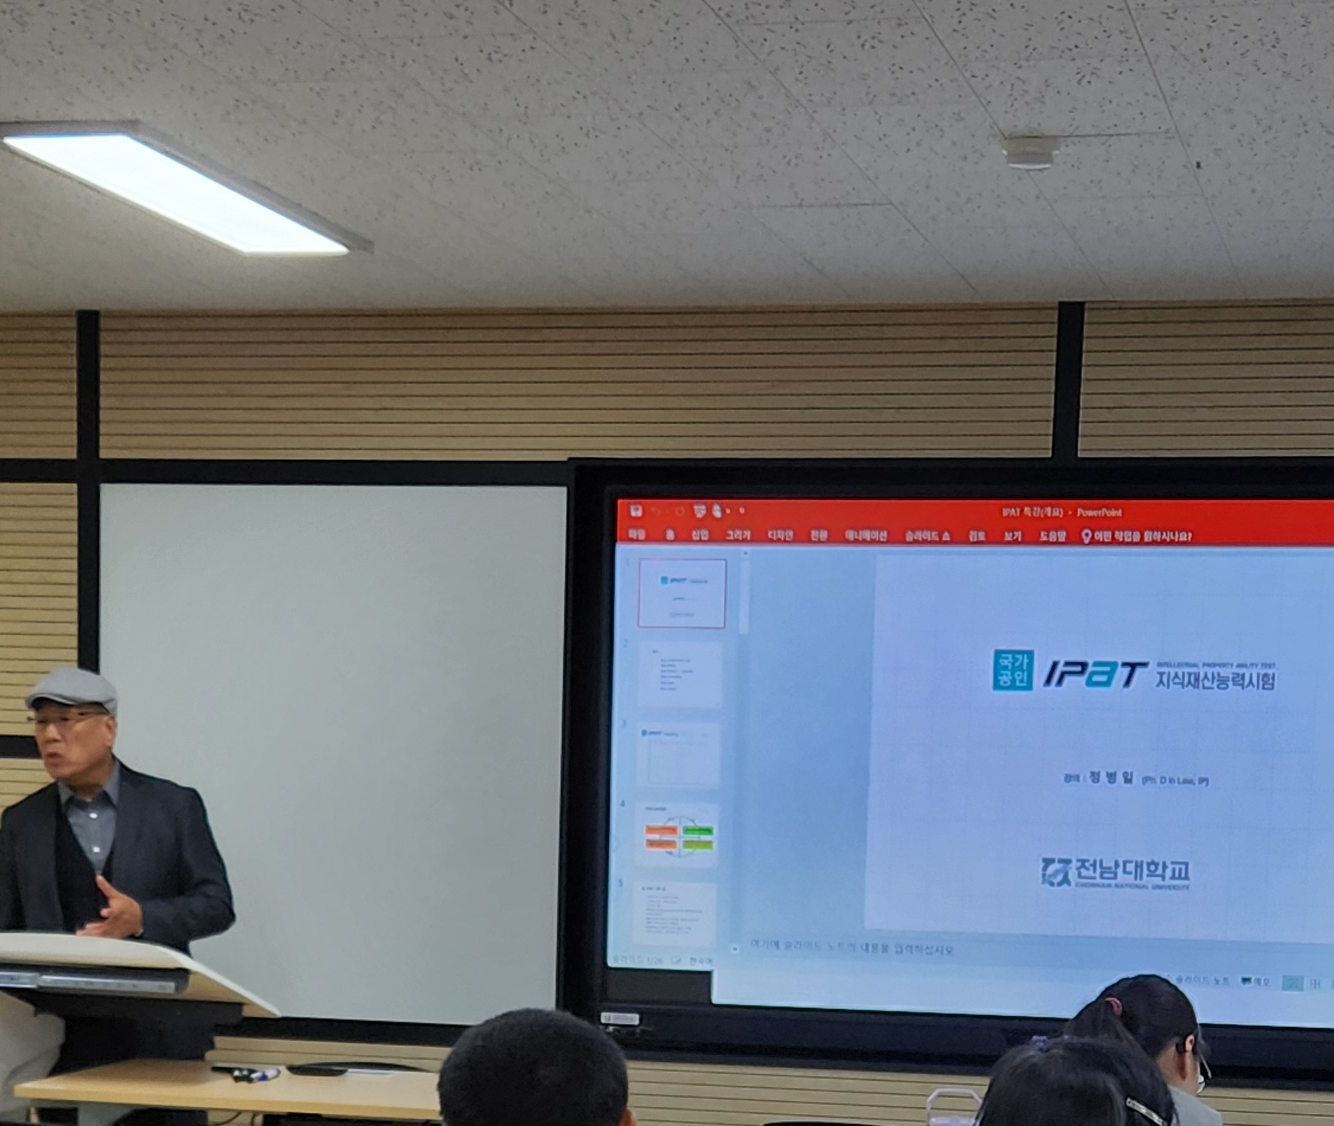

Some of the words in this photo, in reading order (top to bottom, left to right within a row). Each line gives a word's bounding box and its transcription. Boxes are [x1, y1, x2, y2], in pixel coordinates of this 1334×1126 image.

[1077, 507, 1122, 518] PowerPoint
[725, 528, 751, 541] 그리기
[768, 528, 794, 541] 디자인
[845, 528, 888, 542] 애니메이션
[905, 529, 940, 542] 슬라이드
[1004, 530, 1022, 542] 보기
[998, 653, 1030, 670] 국가
[1202, 661, 1234, 669] PROPERTY
[997, 670, 1028, 687] 공인
[1155, 670, 1276, 691] 지식재산능력시험
[1075, 858, 1191, 882] 전남대학교
